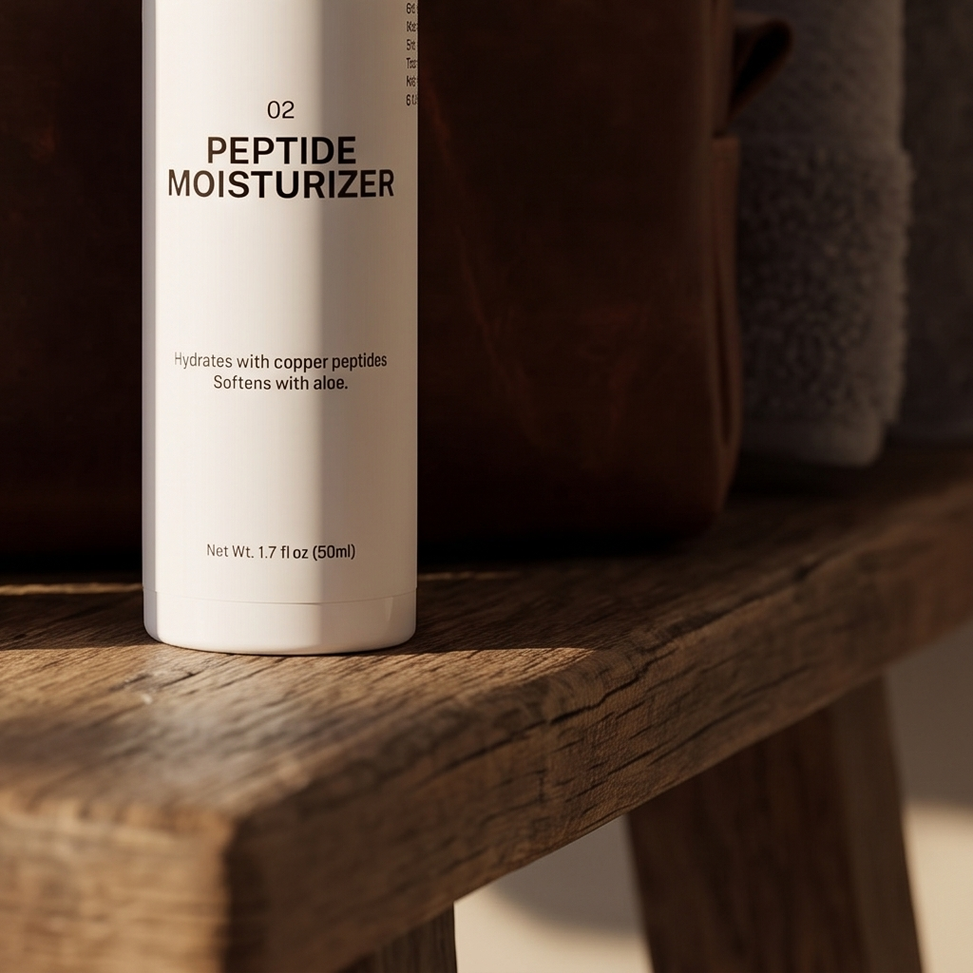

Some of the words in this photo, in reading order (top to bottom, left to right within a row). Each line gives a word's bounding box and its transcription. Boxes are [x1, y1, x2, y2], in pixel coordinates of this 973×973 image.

[267, 100, 294, 119] 02
[207, 136, 357, 165] PEPTIDE
[168, 169, 395, 199] MOISTURIZER
[174, 352, 233, 370] Hydrates
[236, 354, 270, 369] with
[273, 358, 329, 373] copper
[331, 352, 388, 372] peptides
[213, 375, 271, 390] Softens
[275, 375, 309, 390] with
[313, 375, 349, 390] aloe.
[206, 544, 229, 558] Net
[232, 545, 255, 559] Wt.
[258, 545, 277, 559] 1.7
[280, 545, 290, 559] fl
[293, 548, 309, 560] oz
[312, 543, 356, 562] (50ml)
